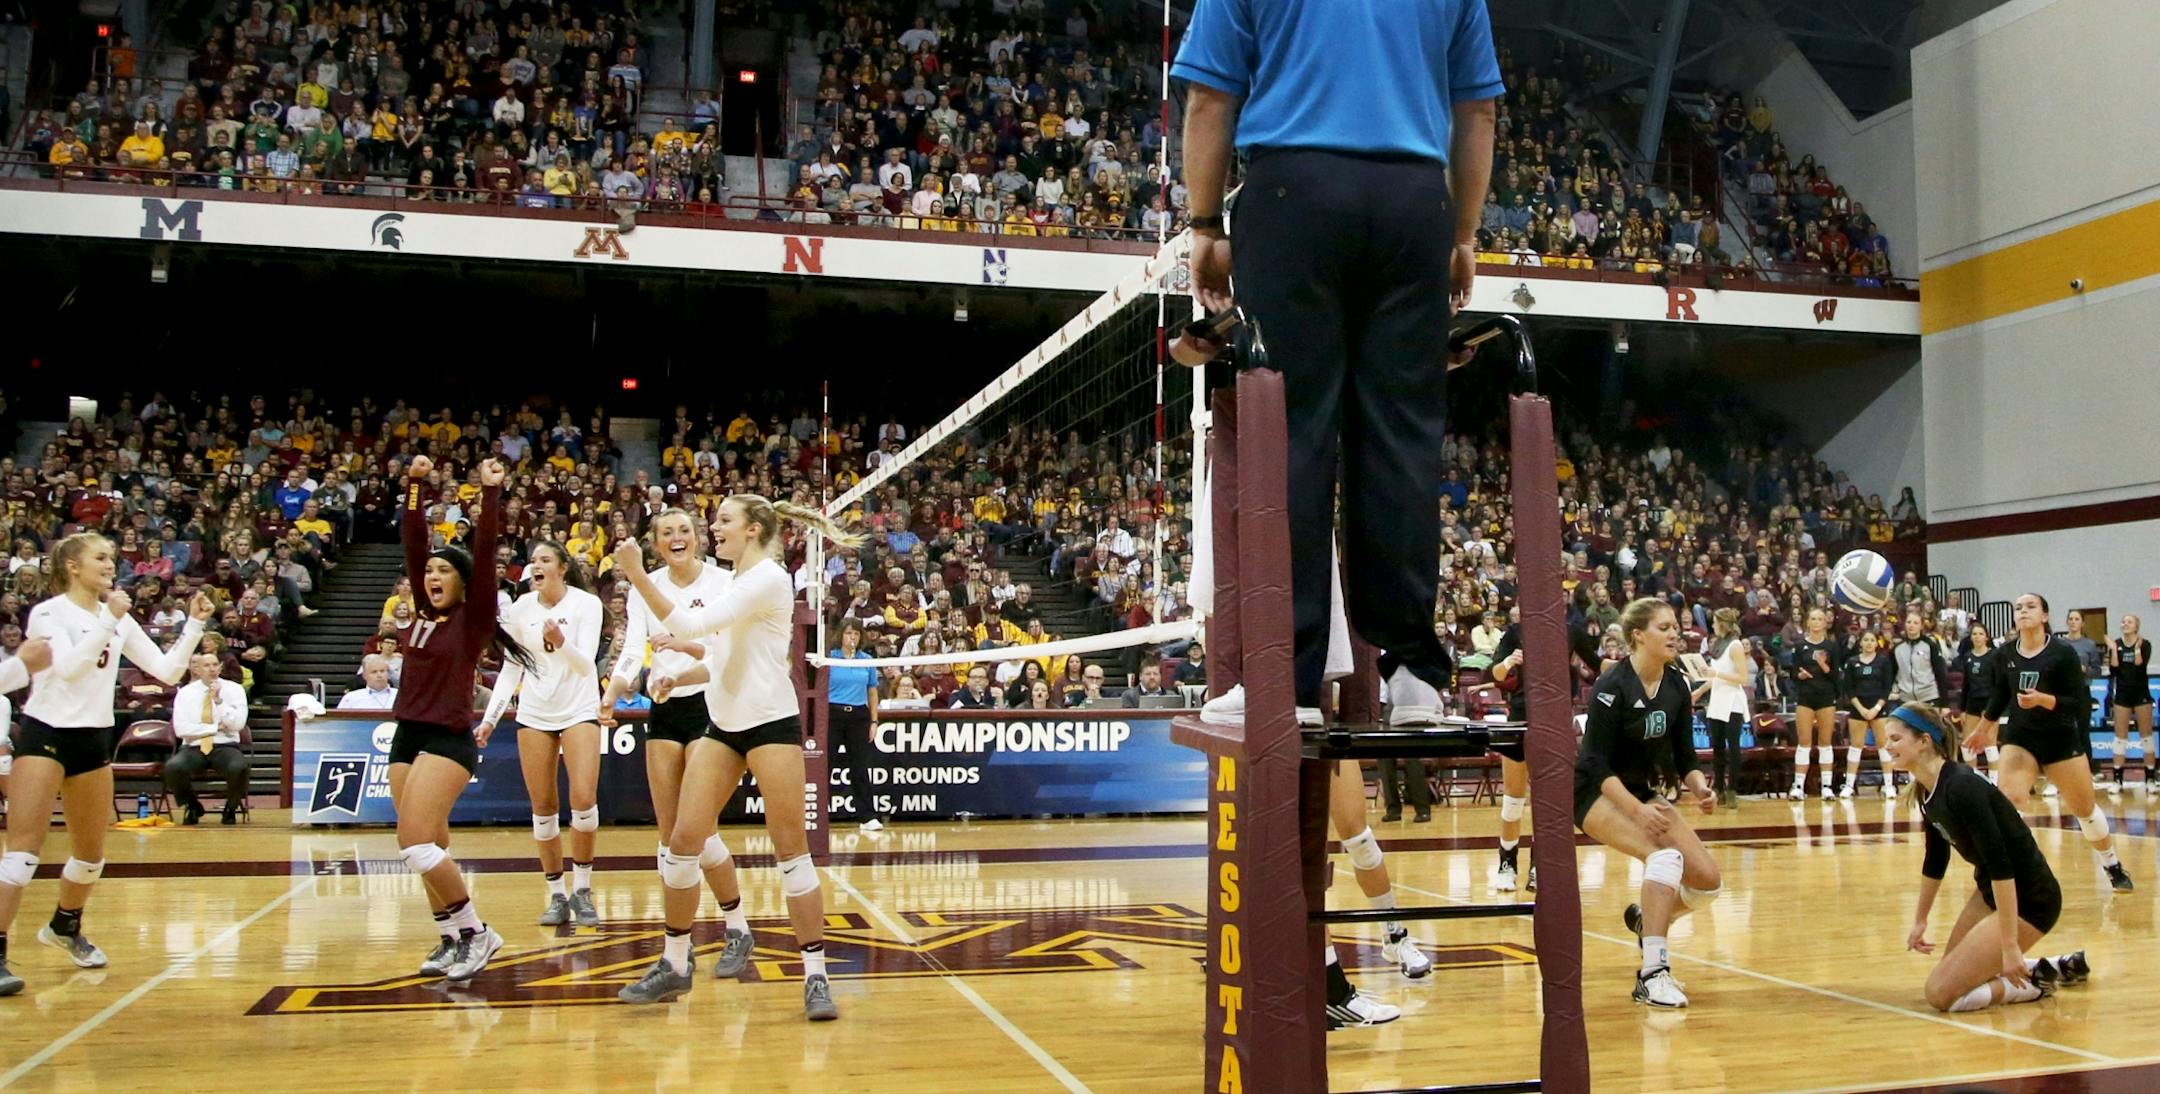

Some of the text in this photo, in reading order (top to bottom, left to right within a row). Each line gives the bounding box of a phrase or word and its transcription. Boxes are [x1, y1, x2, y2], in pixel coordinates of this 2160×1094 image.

[140, 198, 203, 241] M
[573, 227, 629, 260] M
[783, 236, 823, 273] N
[1666, 287, 1699, 321] R
[1813, 299, 1838, 324] W
[409, 629, 436, 649] 17
[2019, 671, 2040, 690] 17
[874, 722, 1131, 753] CHAMPIONSHIP
[1643, 710, 1667, 740] 18
[893, 767, 980, 785] ROUNDS
[902, 794, 937, 812] MN
